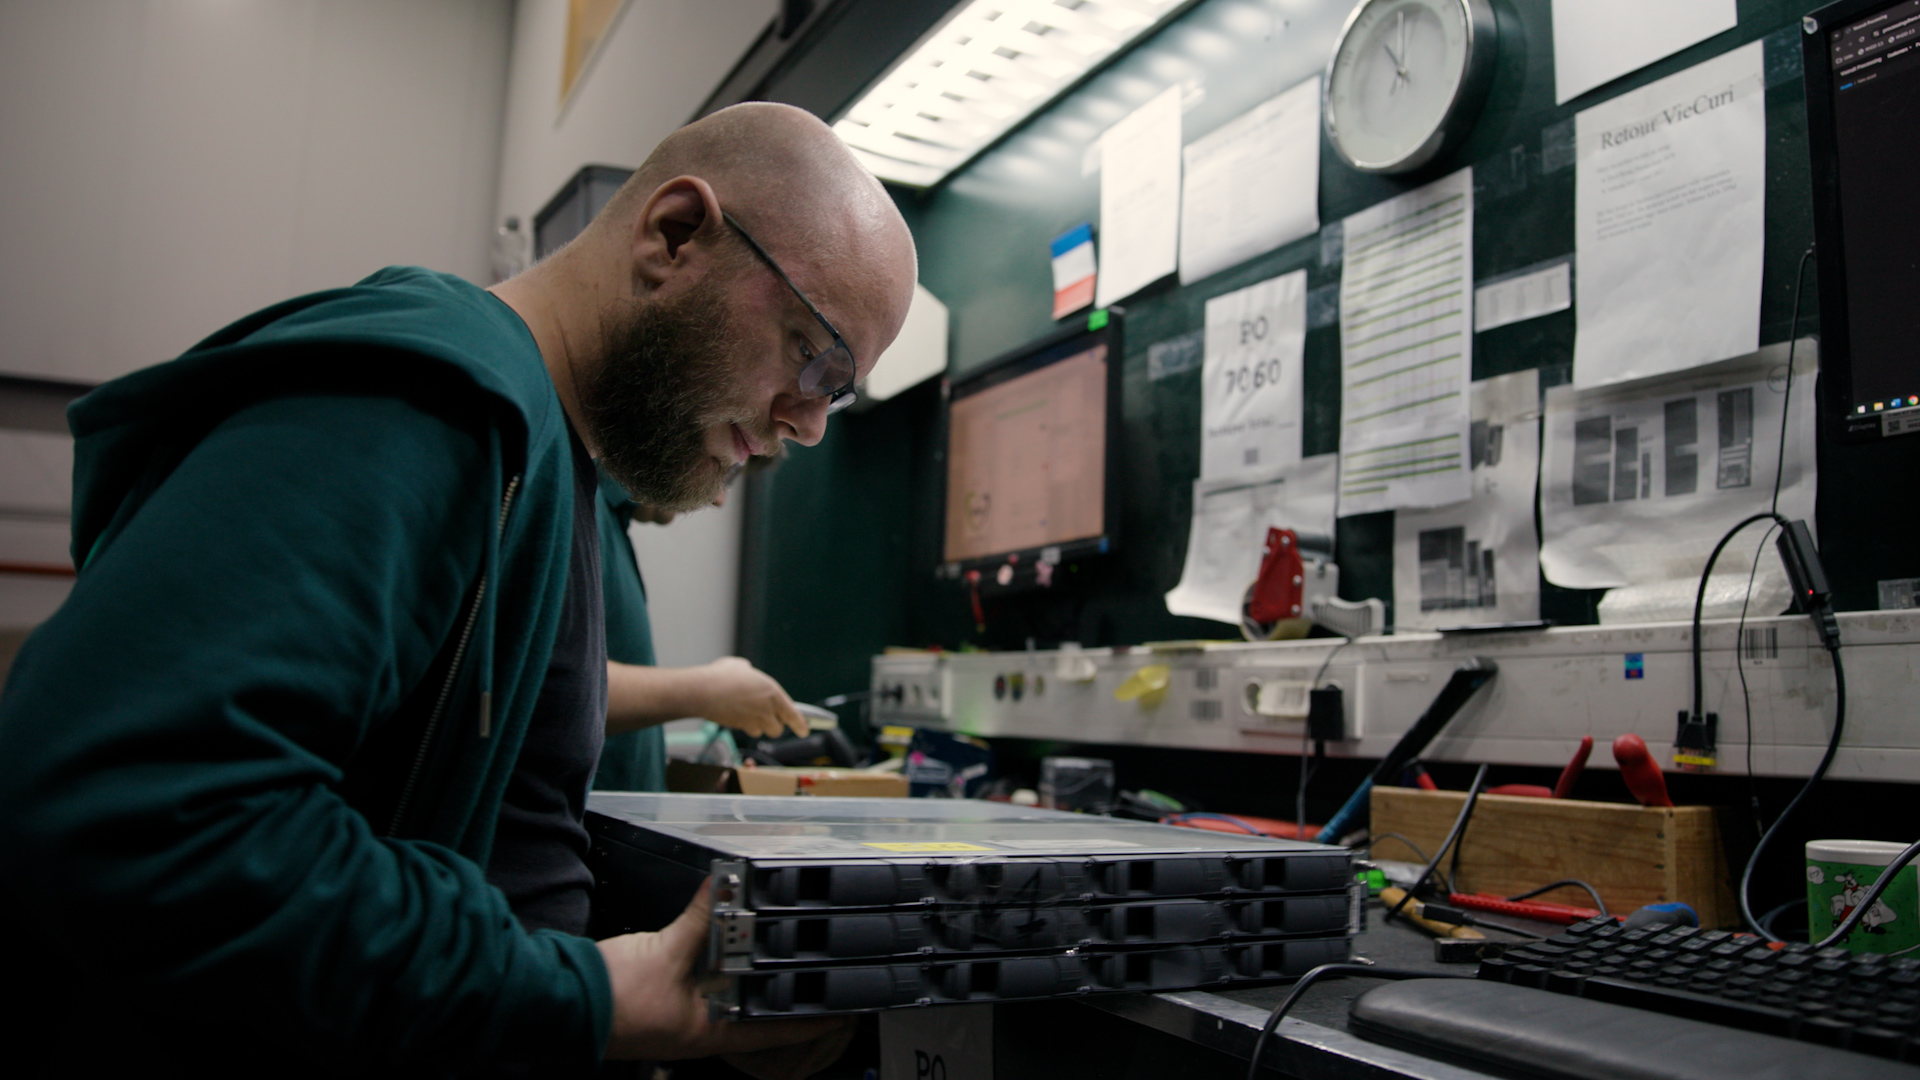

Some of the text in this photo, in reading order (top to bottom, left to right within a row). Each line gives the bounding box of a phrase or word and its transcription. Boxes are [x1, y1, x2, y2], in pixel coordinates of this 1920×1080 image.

[1601, 84, 1734, 150] Retour VieCuri
[1240, 316, 1269, 346] PO
[1226, 359, 1281, 395] 7060
